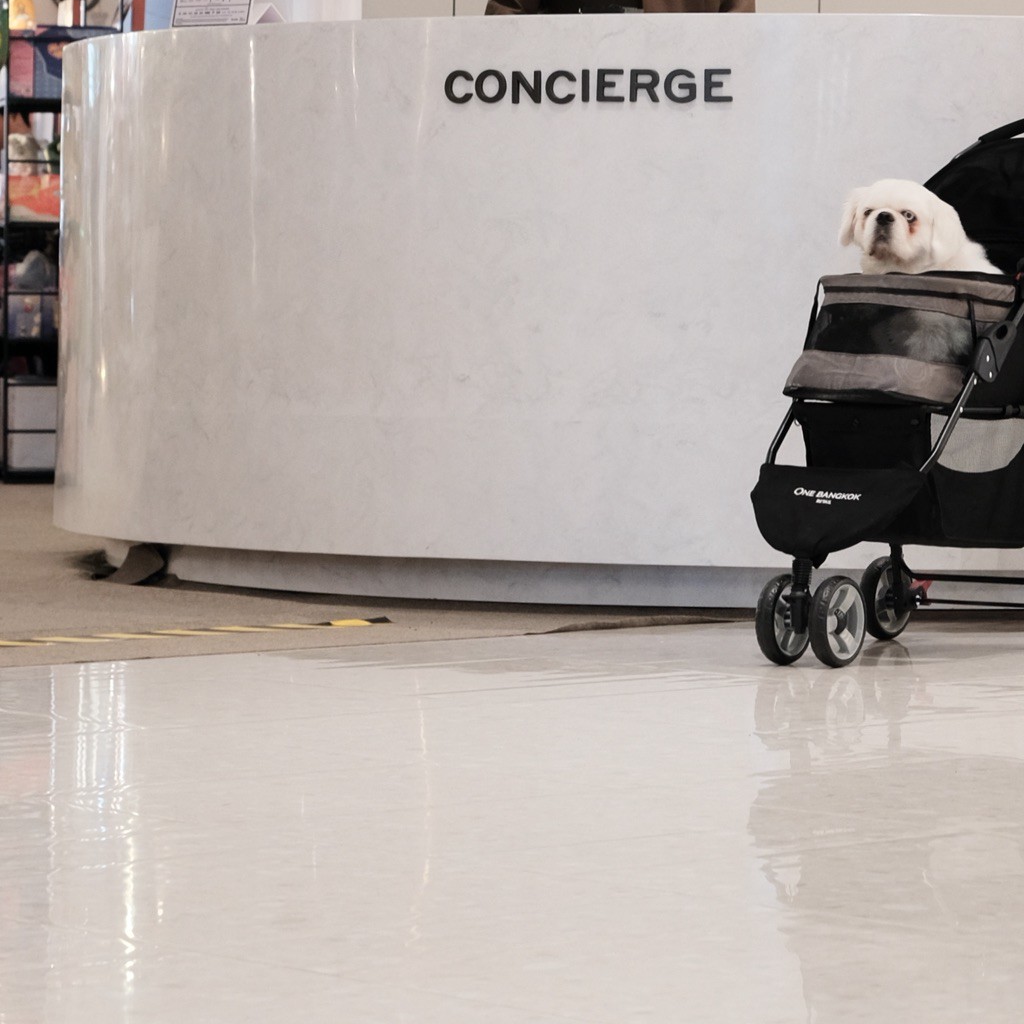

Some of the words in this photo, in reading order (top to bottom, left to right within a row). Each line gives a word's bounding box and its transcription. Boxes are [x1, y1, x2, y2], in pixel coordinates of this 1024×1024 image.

[444, 68, 734, 104] CONCIERGE
[793, 487, 816, 497] ONE
[815, 491, 861, 500] BANGKOK
